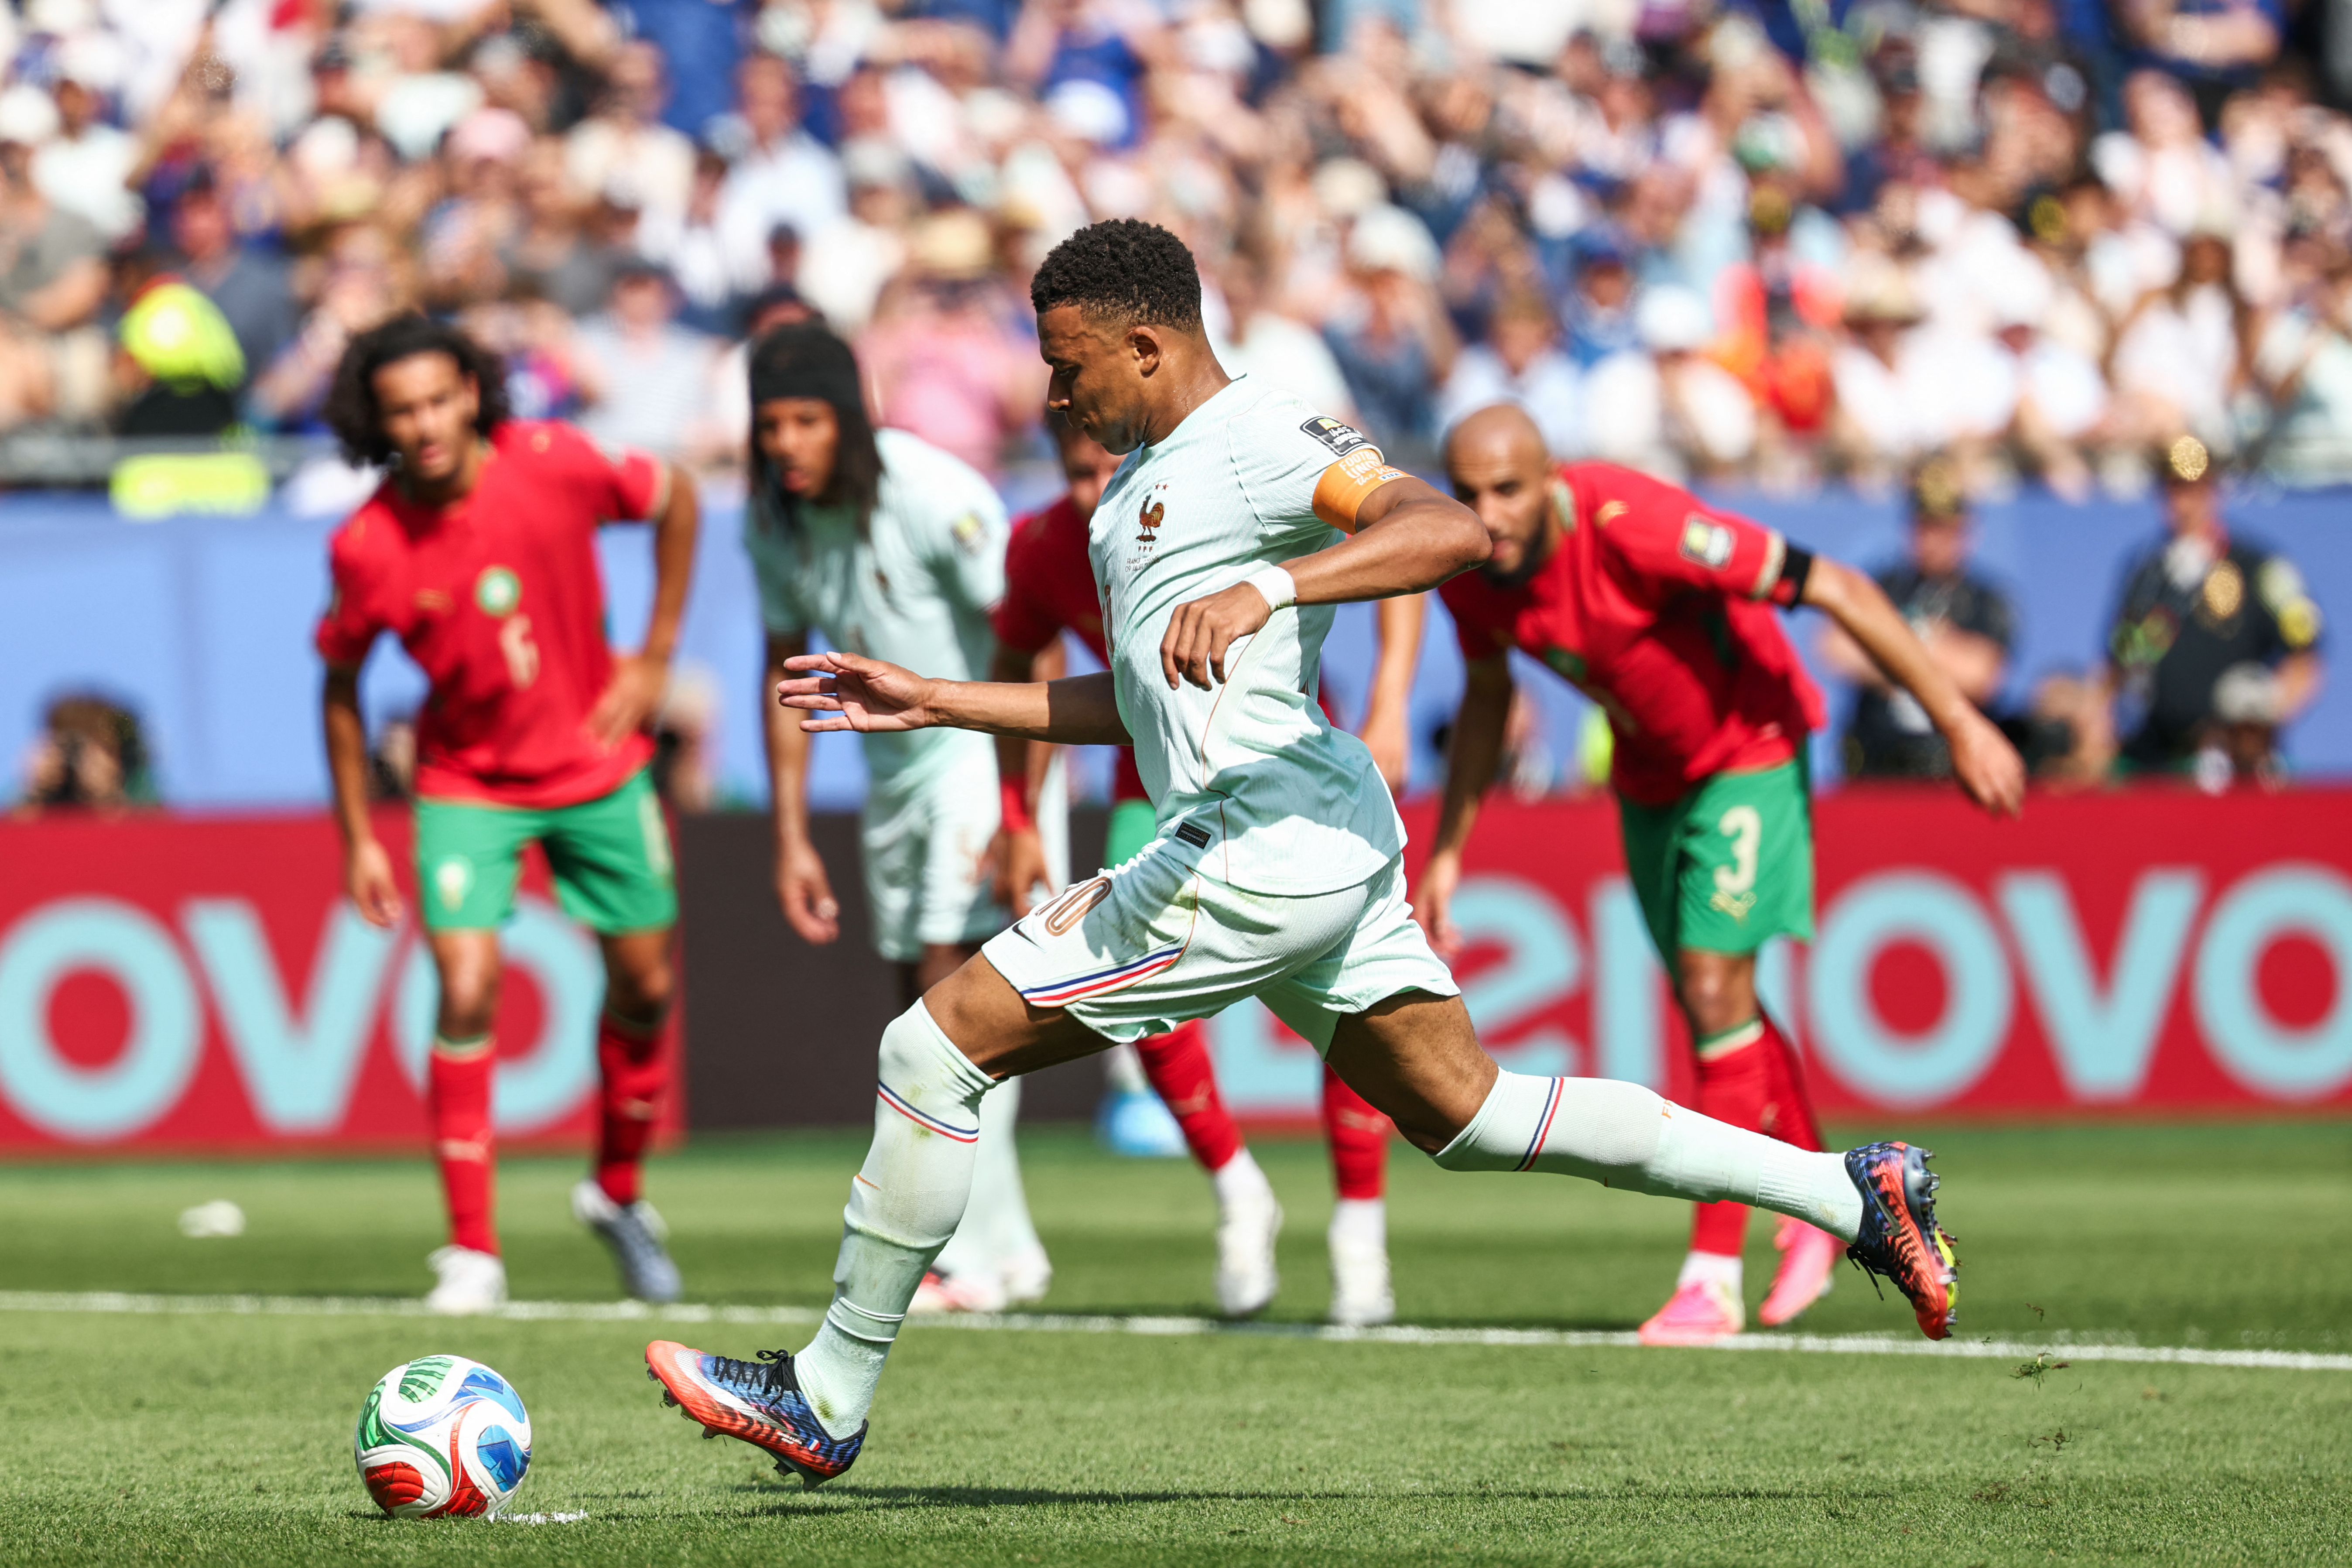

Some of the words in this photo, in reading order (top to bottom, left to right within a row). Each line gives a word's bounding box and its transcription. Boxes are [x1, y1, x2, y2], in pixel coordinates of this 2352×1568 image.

[1333, 432, 1364, 445] EDUCATI
[1339, 451, 1381, 471] FOOTBA
[1345, 461, 1382, 479] UNIT
[1354, 473, 1376, 485] the
[1714, 805, 1761, 894] 3
